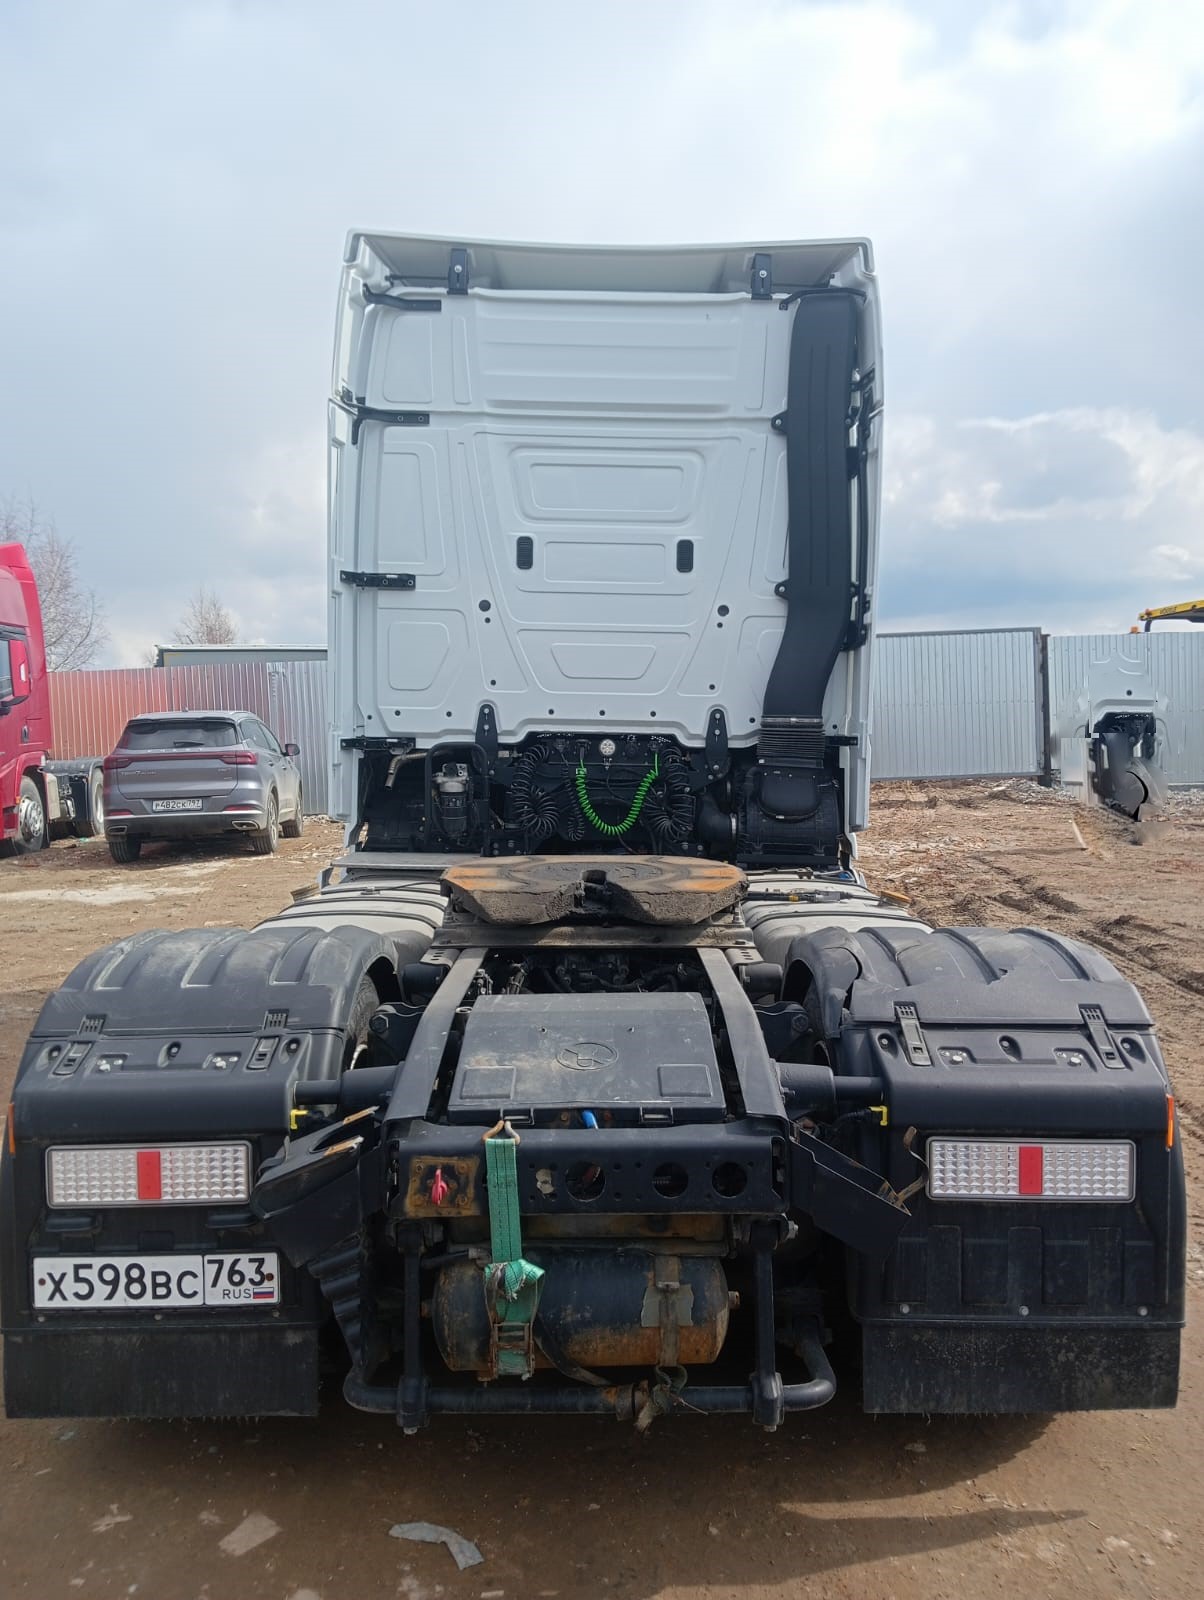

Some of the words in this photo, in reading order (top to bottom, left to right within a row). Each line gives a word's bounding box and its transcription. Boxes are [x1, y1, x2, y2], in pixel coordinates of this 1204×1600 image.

[46, 1263, 199, 1301] Х598ВС
[206, 1257, 266, 1289] 763
[222, 1288, 252, 1300] RUS
